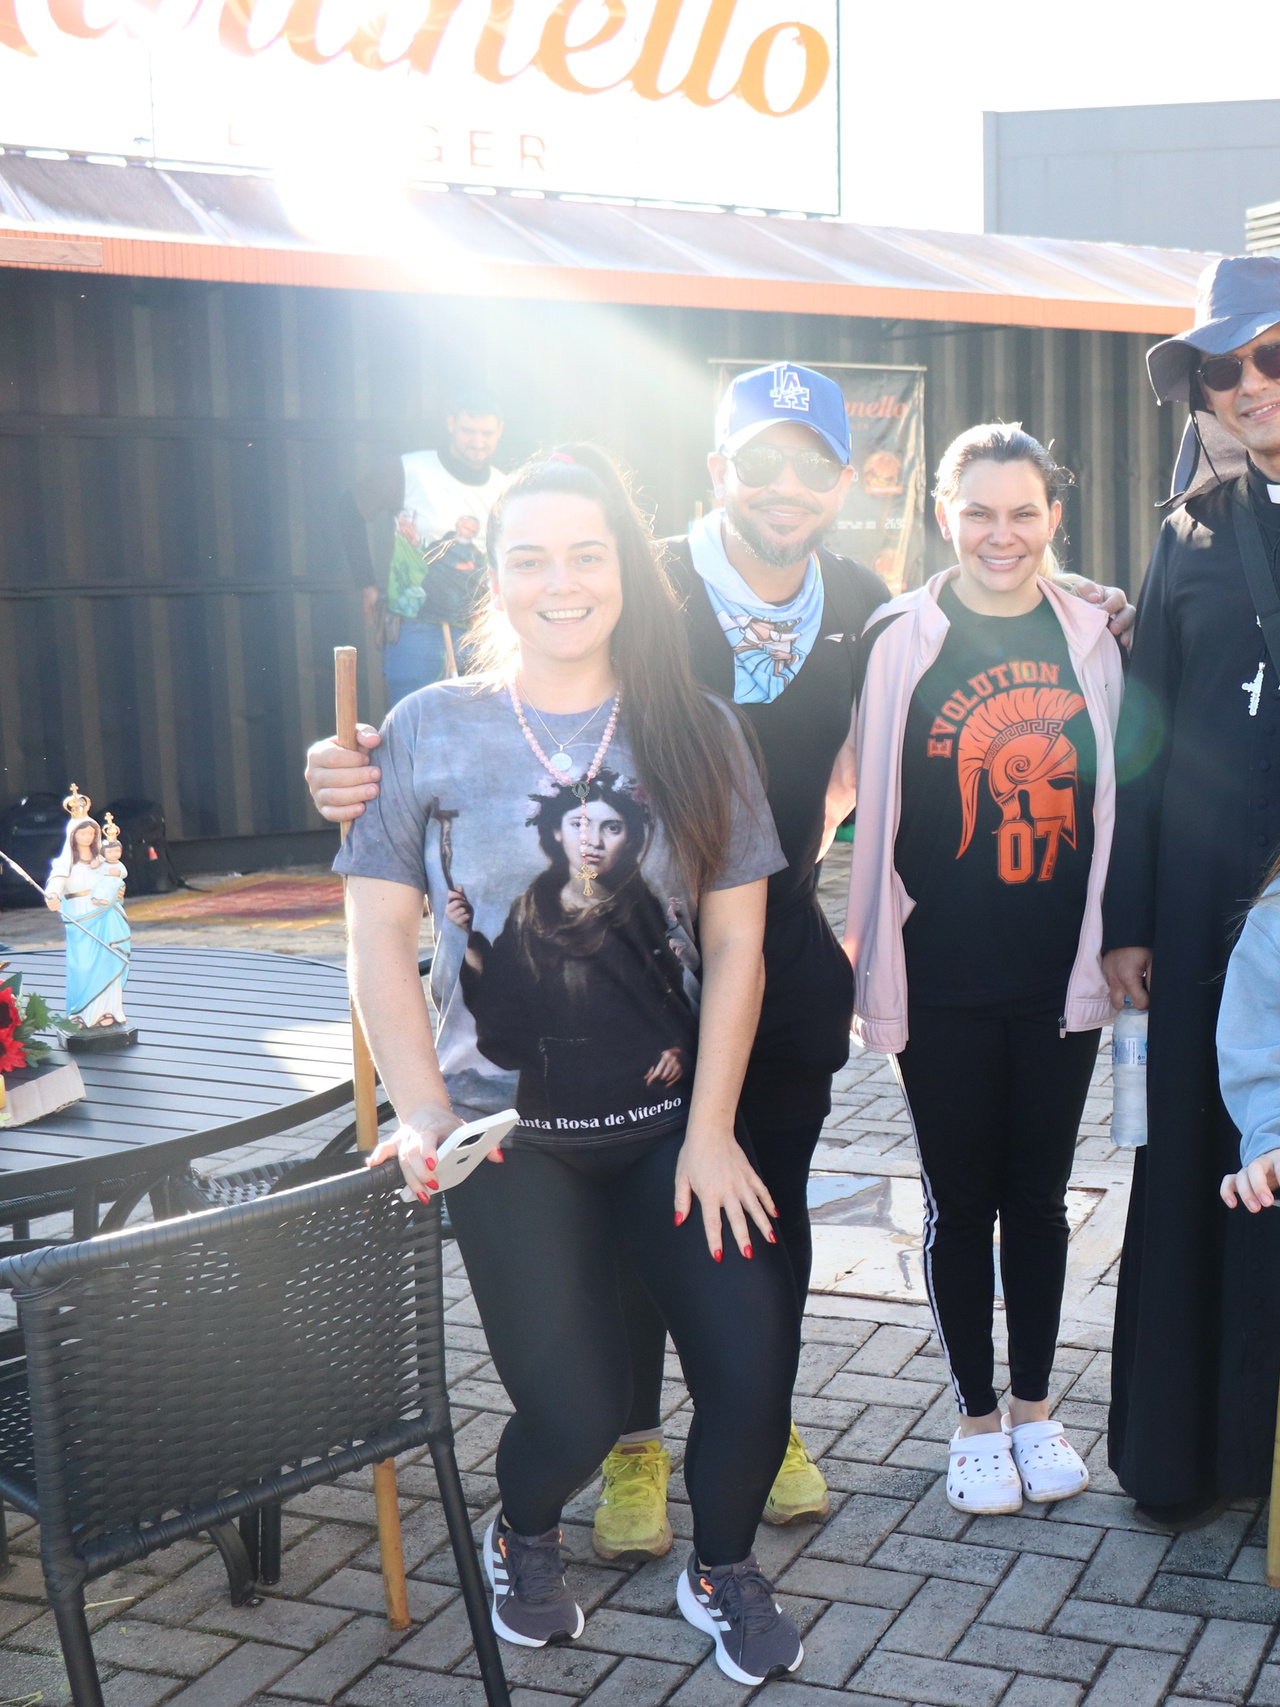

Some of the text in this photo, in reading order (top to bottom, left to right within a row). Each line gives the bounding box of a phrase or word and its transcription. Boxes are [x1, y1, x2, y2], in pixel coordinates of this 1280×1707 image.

[770, 364, 810, 411] LA
[927, 661, 1060, 758] EVOLUTION
[997, 815, 1067, 884] 07
[516, 1097, 682, 1130] anta Rosa de Viterbo
